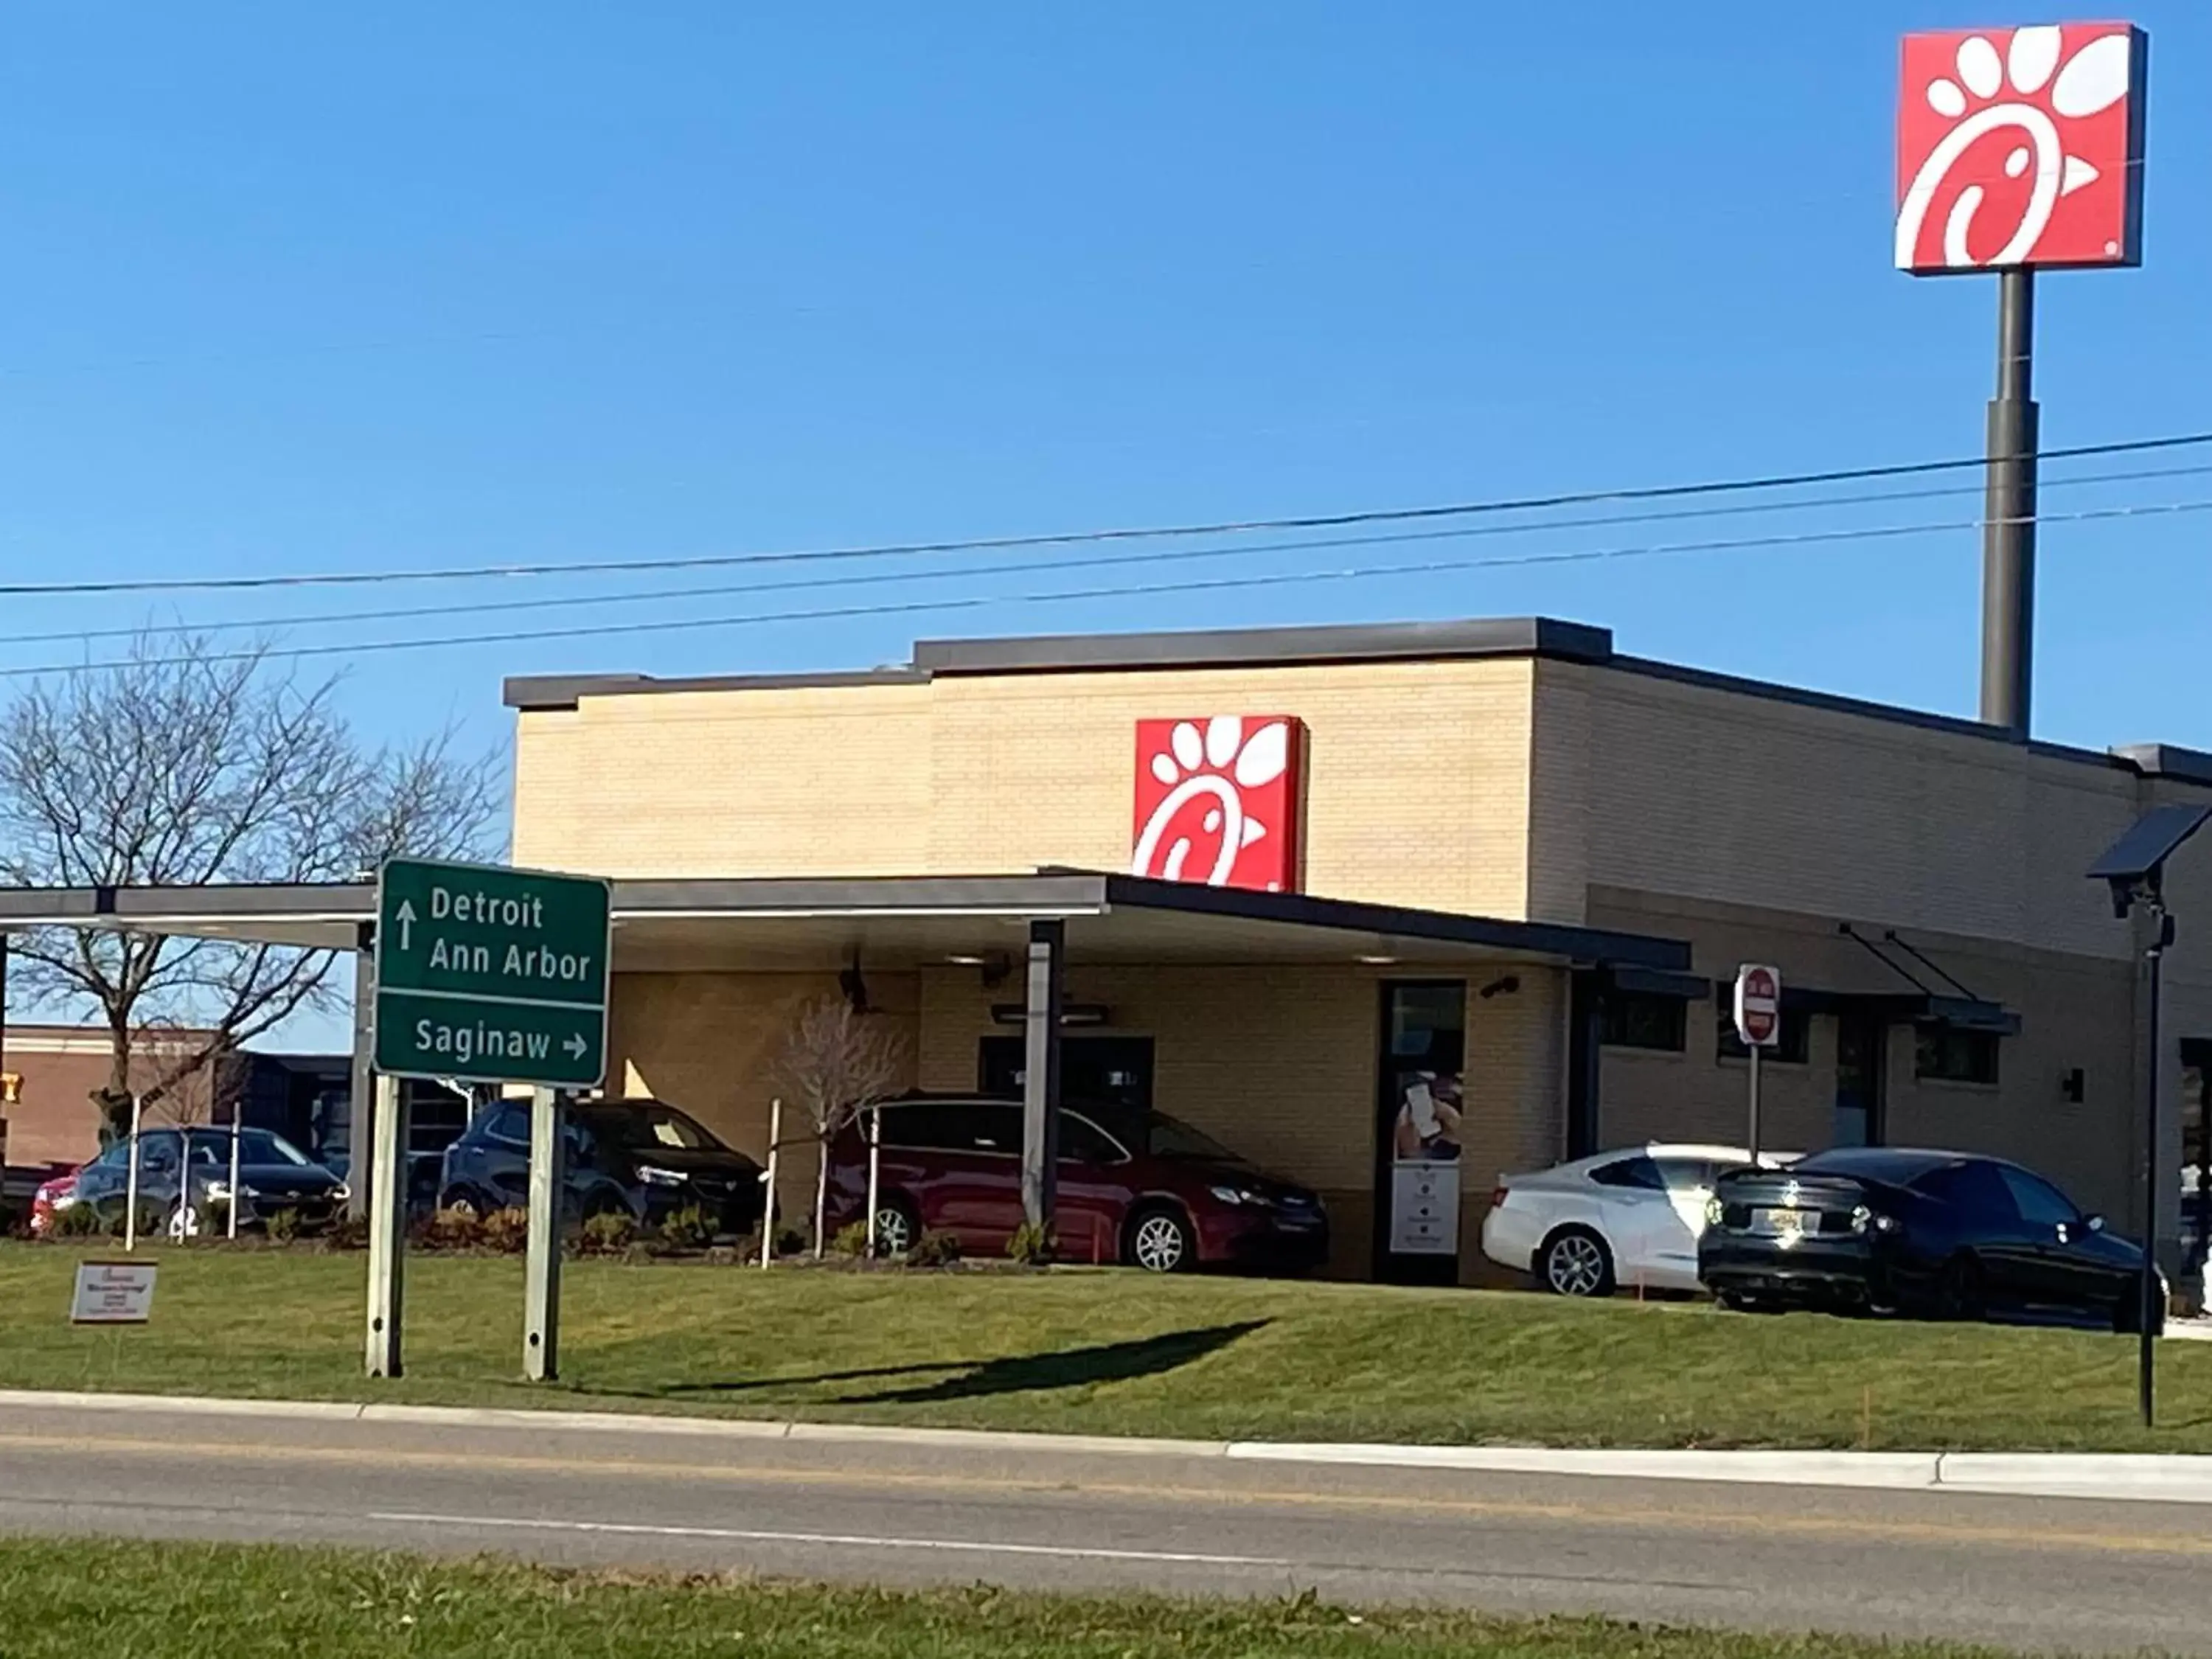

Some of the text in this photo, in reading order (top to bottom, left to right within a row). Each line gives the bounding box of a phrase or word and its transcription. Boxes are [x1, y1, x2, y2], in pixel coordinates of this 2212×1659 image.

[431, 887, 543, 928] Detroit
[429, 938, 591, 981] Ann Arbor
[415, 1019, 551, 1063] Saginaw
